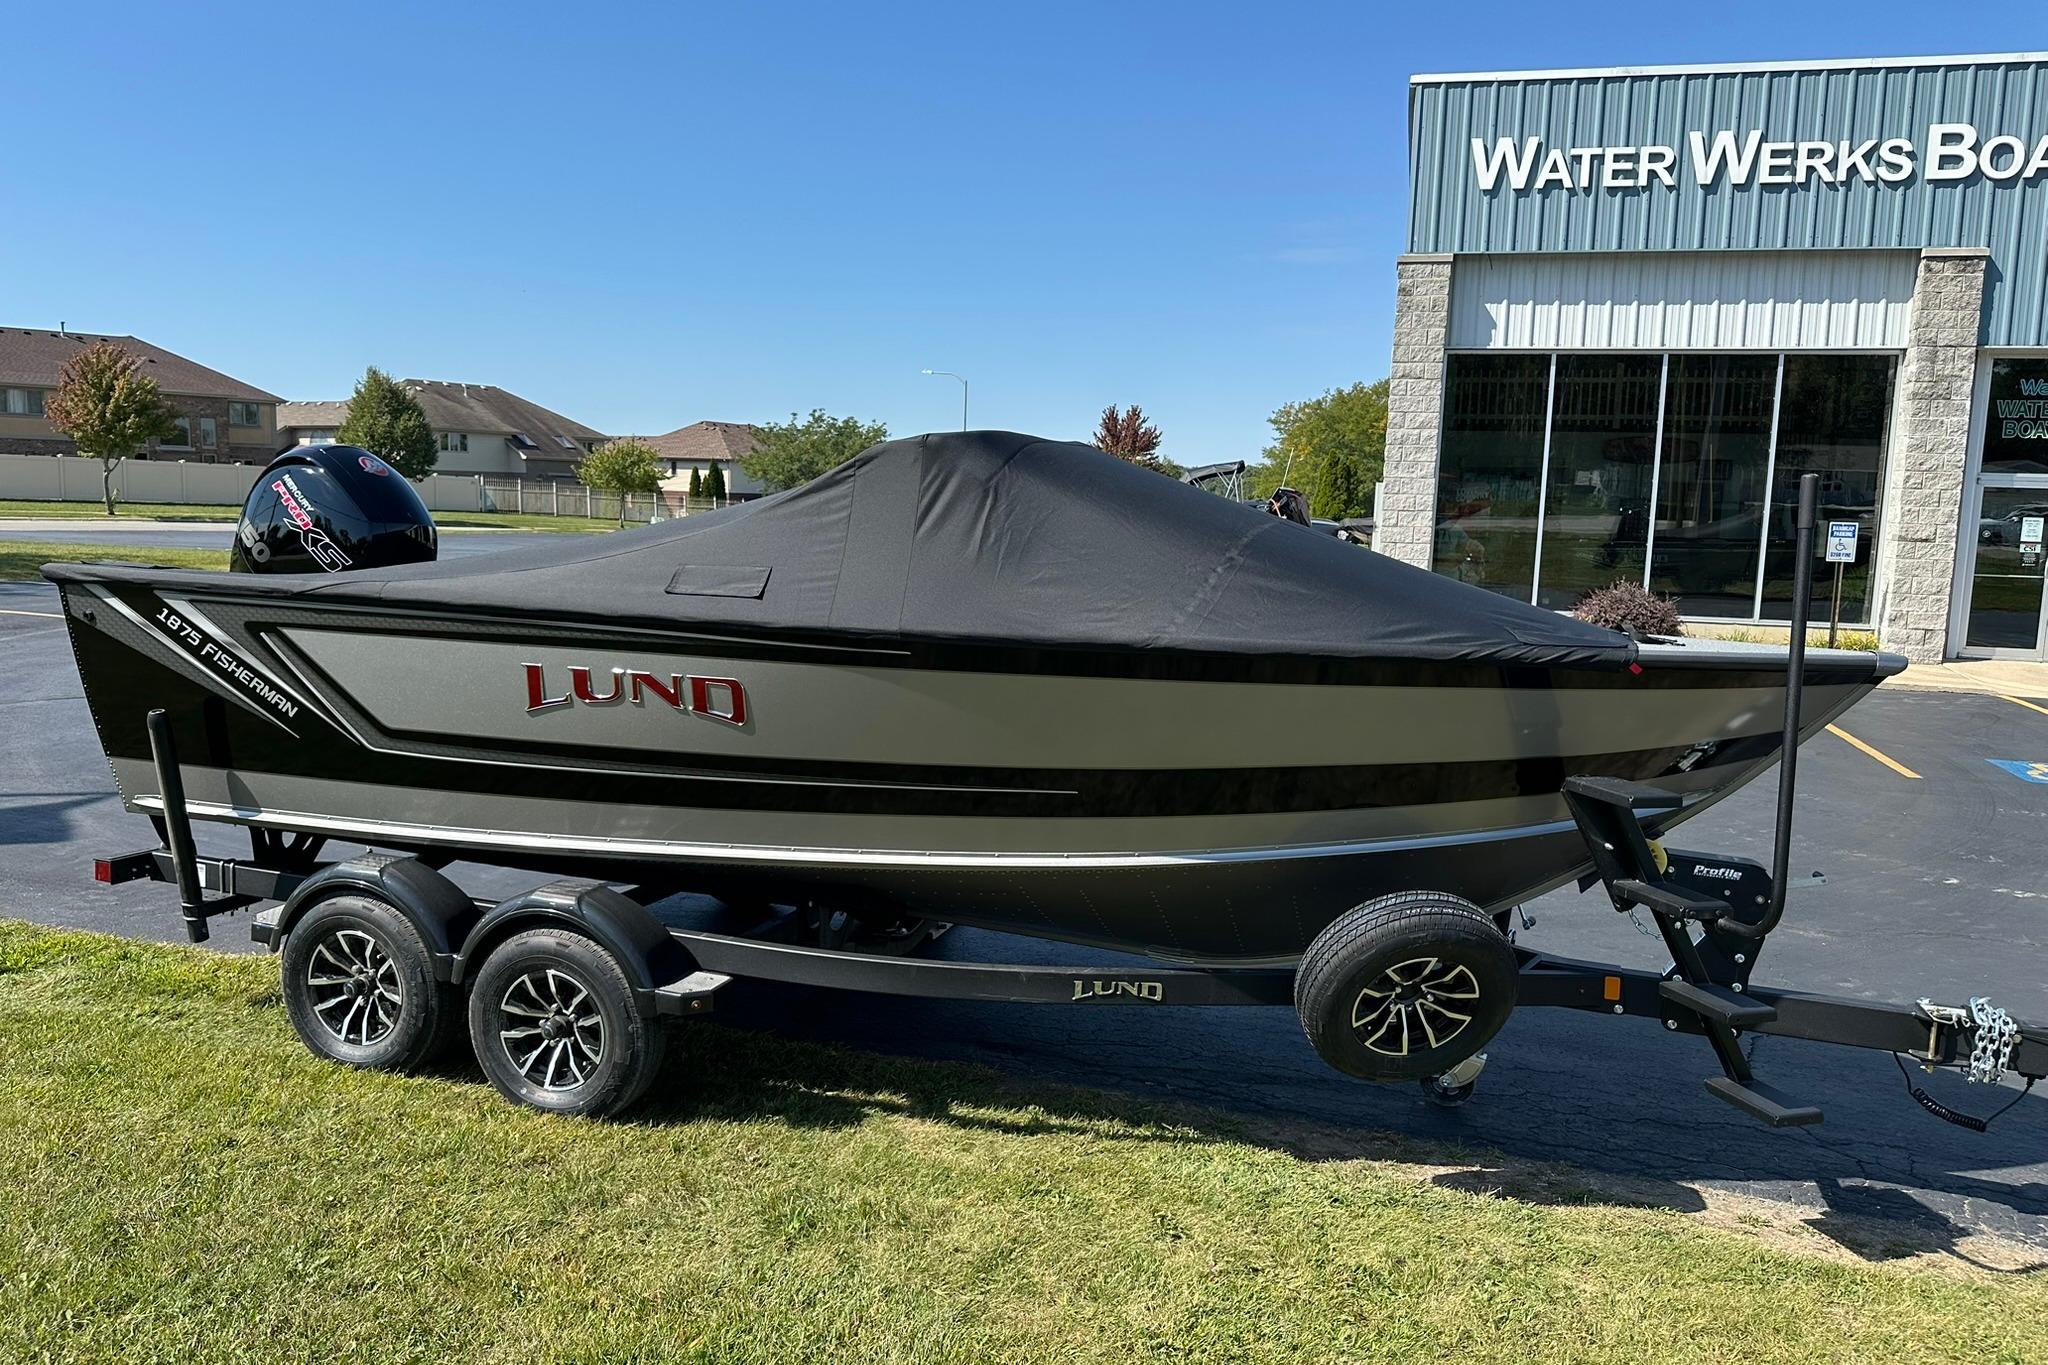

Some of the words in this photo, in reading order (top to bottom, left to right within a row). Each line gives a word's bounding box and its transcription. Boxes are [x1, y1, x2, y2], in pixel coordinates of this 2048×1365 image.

[1472, 136, 1677, 190] WATER
[1690, 129, 1914, 186] WERKS
[1925, 123, 2048, 179] BOA
[2002, 420, 2048, 439] BOA
[272, 480, 312, 530] PRO
[282, 474, 314, 511] MERCURY
[283, 518, 353, 572] XS
[156, 608, 202, 646] 1875
[201, 643, 298, 717] FISHERMAN
[521, 662, 748, 727] LUND
[1693, 864, 1742, 879] Profile
[1072, 980, 1163, 1001] LUND
